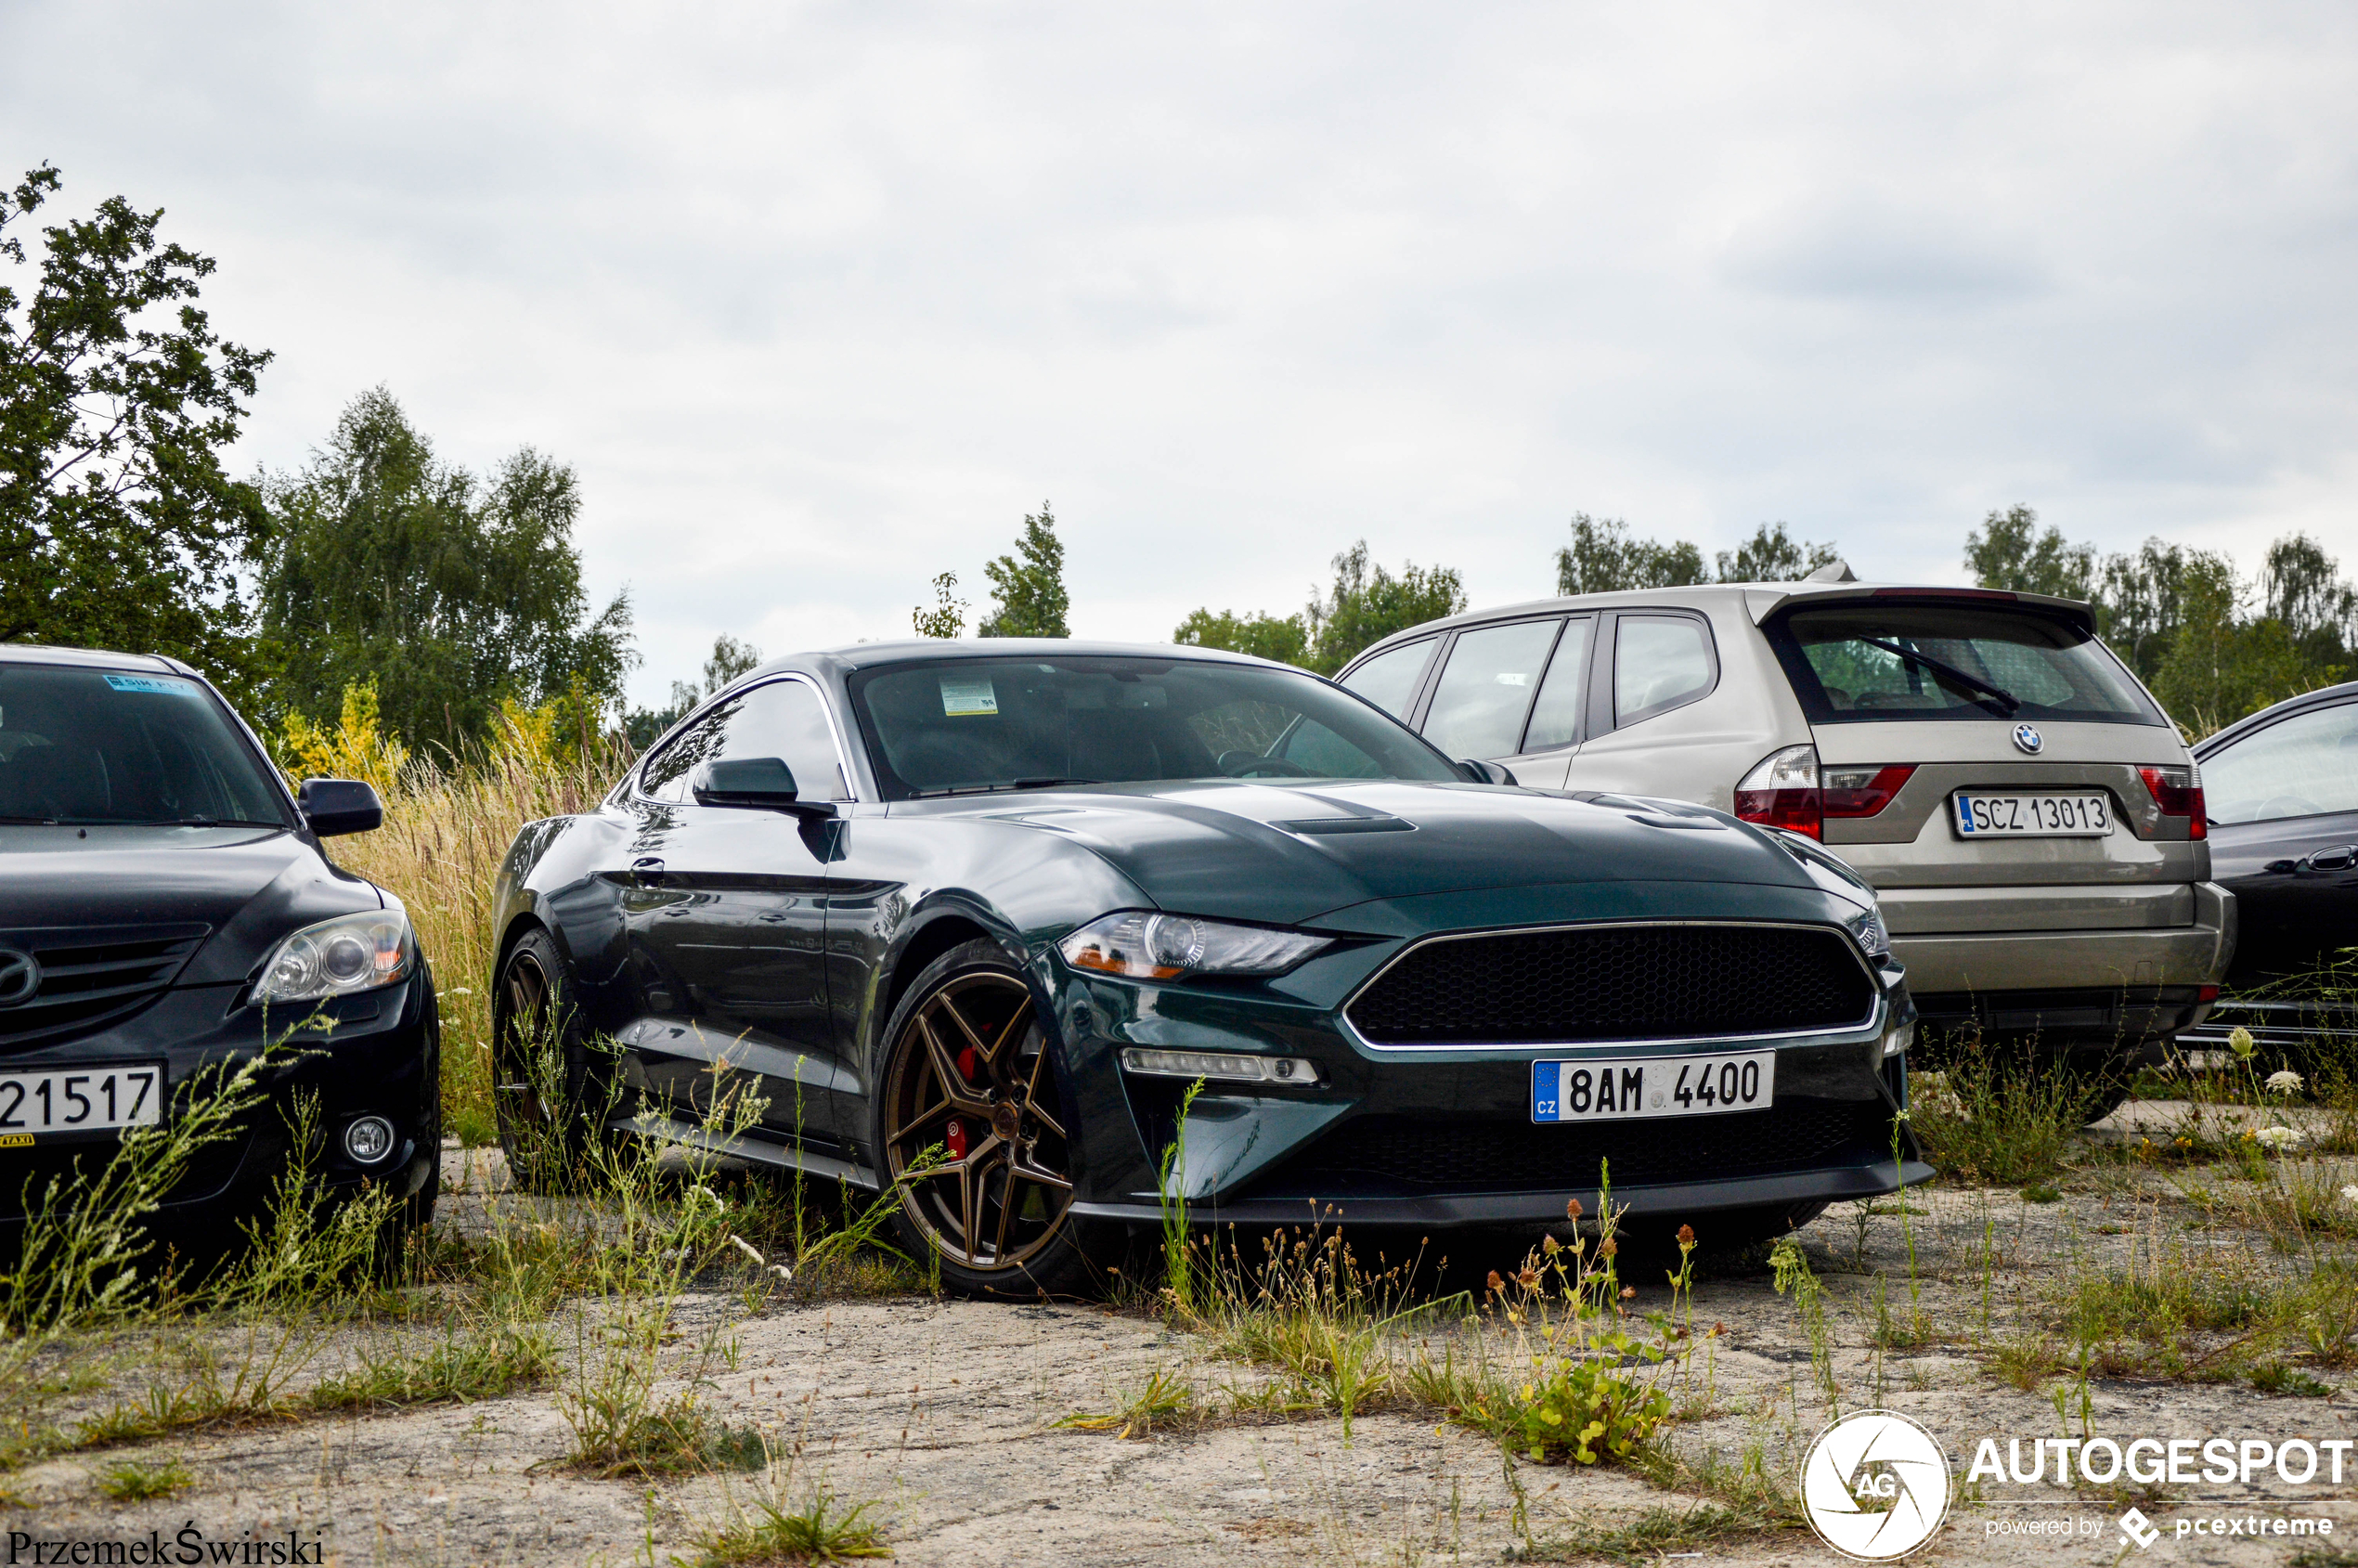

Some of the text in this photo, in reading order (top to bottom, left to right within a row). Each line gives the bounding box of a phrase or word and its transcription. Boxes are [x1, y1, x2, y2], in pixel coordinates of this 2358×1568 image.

[1962, 819, 1973, 828] PL
[1973, 797, 2106, 830] SCZ 13013
[1569, 1059, 1760, 1113] 8AM 4400
[0, 1071, 154, 1127] 21517
[1536, 1100, 1556, 1114] CZ
[5, 1135, 31, 1146] TAXI
